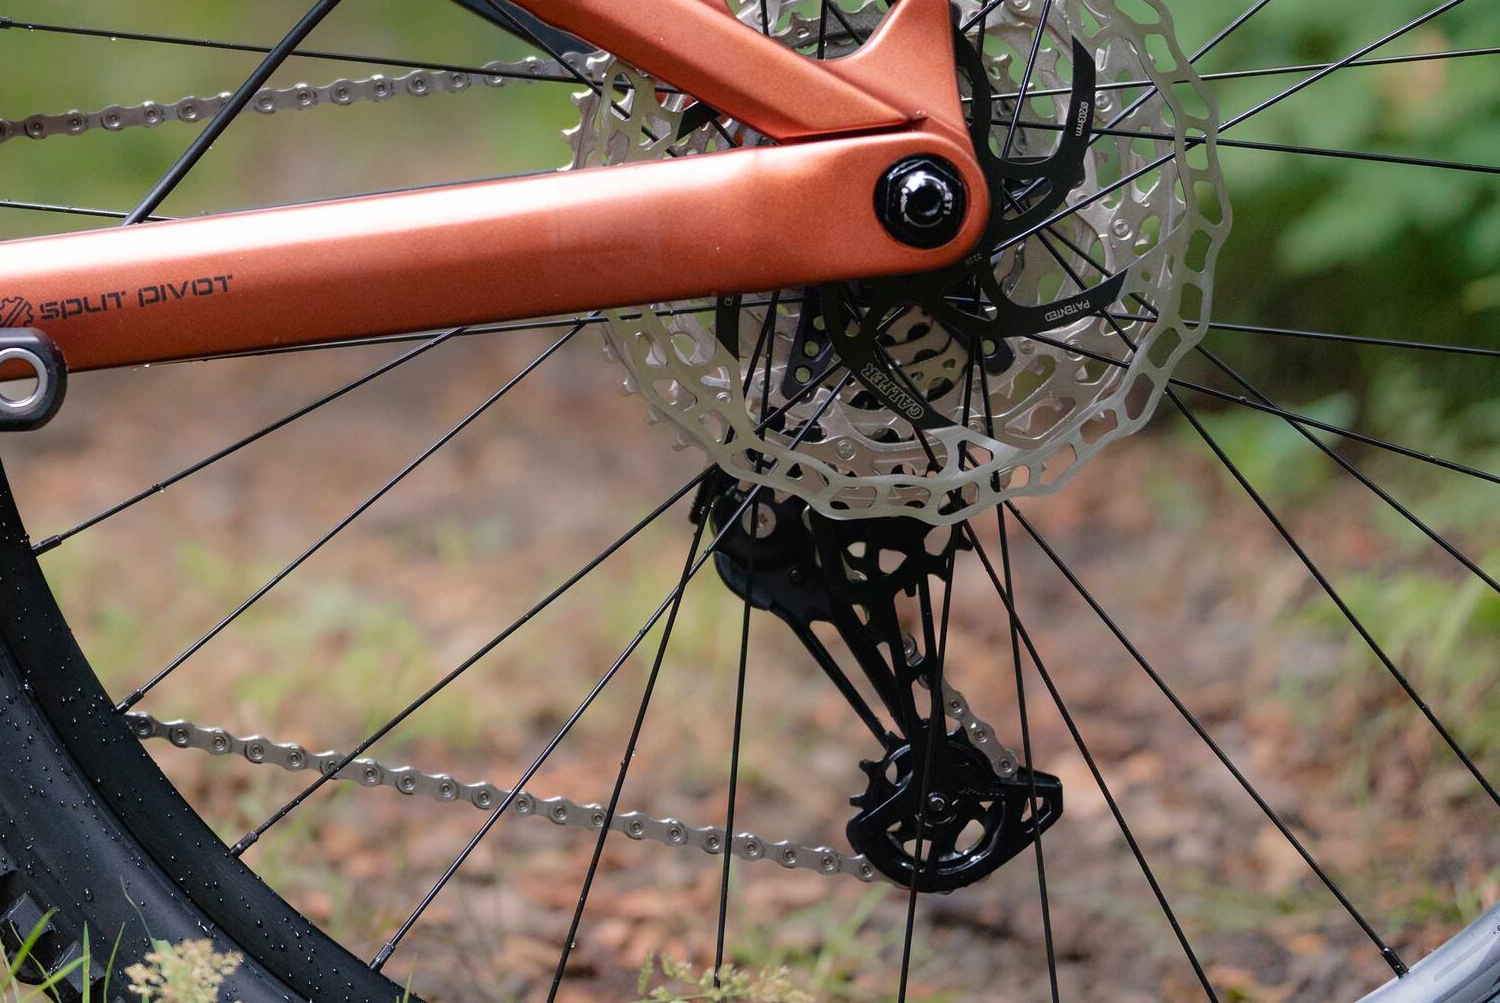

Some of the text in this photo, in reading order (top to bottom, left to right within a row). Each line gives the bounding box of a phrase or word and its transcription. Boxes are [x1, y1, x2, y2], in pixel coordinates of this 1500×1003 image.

[40, 274, 234, 321] SPLIT PIVOT
[1044, 299, 1091, 323] PATENTED
[861, 362, 925, 420] GALFER
